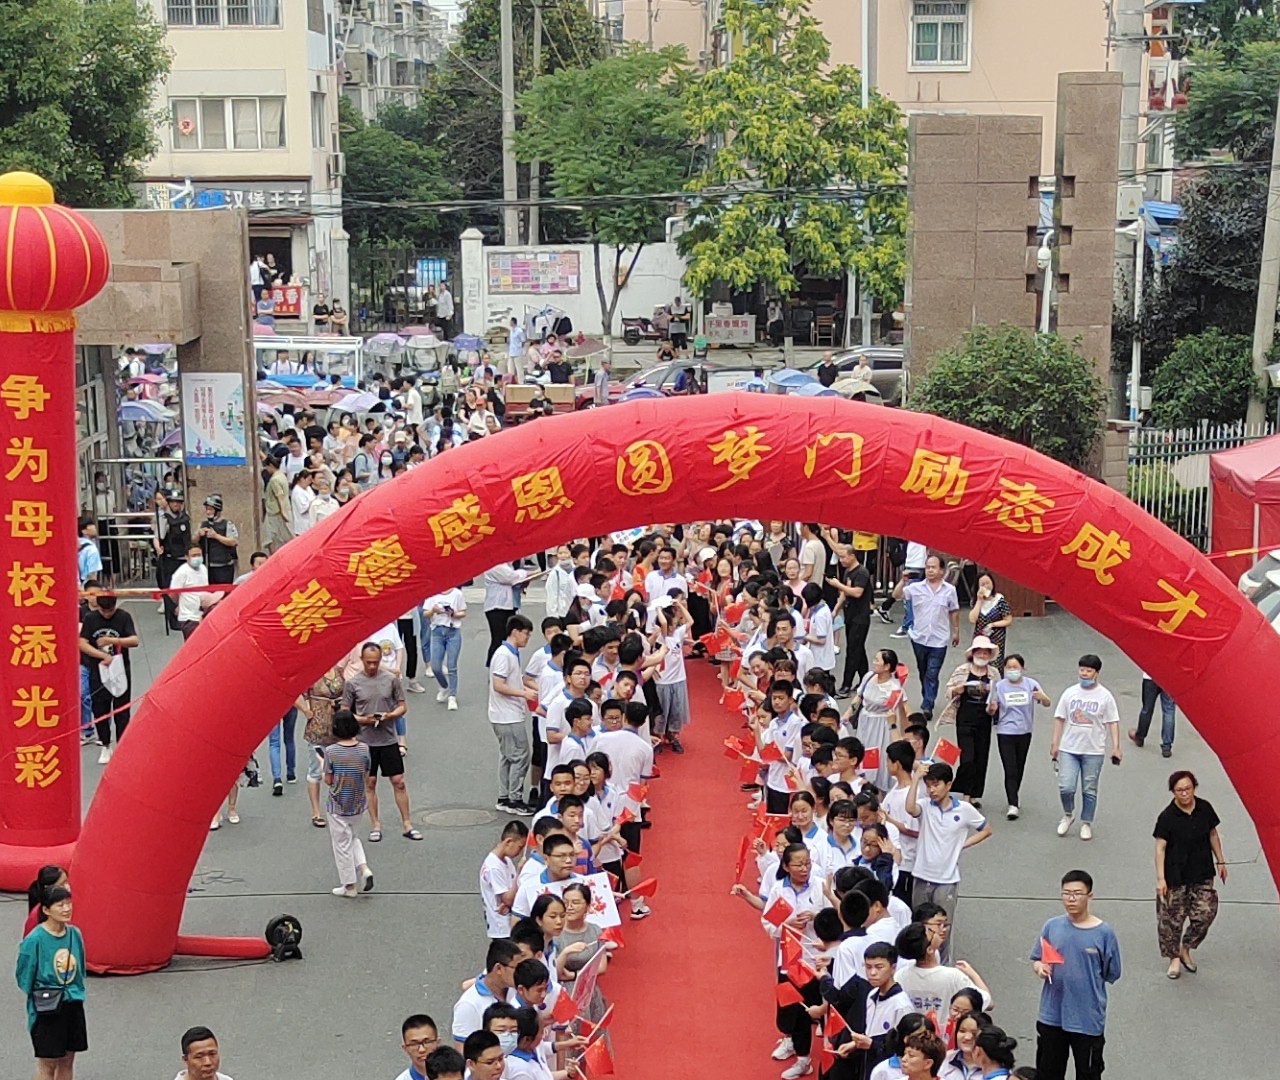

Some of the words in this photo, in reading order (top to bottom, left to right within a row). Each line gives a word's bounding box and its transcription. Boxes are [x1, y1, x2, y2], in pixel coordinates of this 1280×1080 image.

[1, 376, 60, 786] 争为母校添光彩
